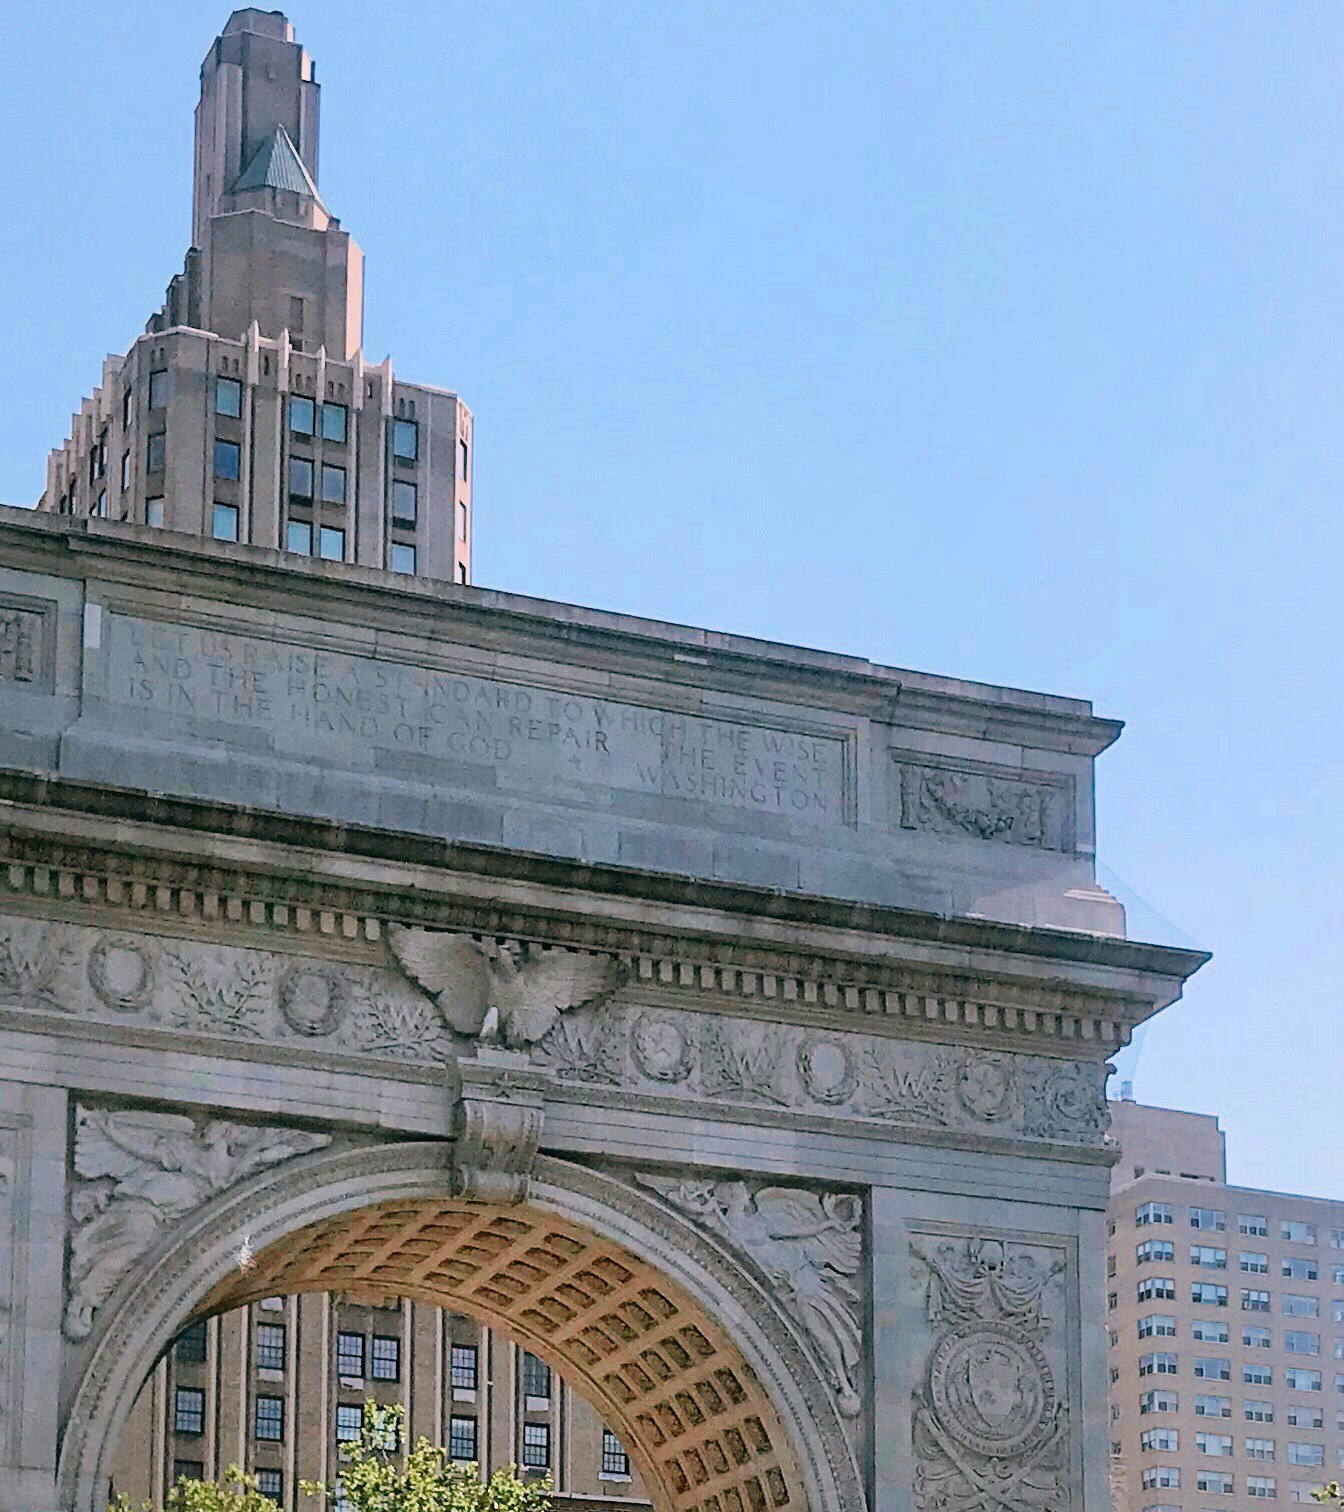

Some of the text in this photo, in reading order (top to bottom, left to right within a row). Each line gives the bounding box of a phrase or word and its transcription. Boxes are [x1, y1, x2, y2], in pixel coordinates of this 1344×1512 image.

[129, 677, 829, 812] IS IN THE HAND OF GOD WASHINGTON
[133, 651, 827, 789] AND THE HONEST CAN REPAIR THE EVENT
[200, 635, 233, 659] US
[244, 643, 328, 675] RAISE
[376, 670, 532, 713] STANDARD
[546, 697, 583, 721] TO
[593, 701, 686, 738] WHICH
[699, 722, 752, 752] THE
[764, 730, 827, 764] WISE
